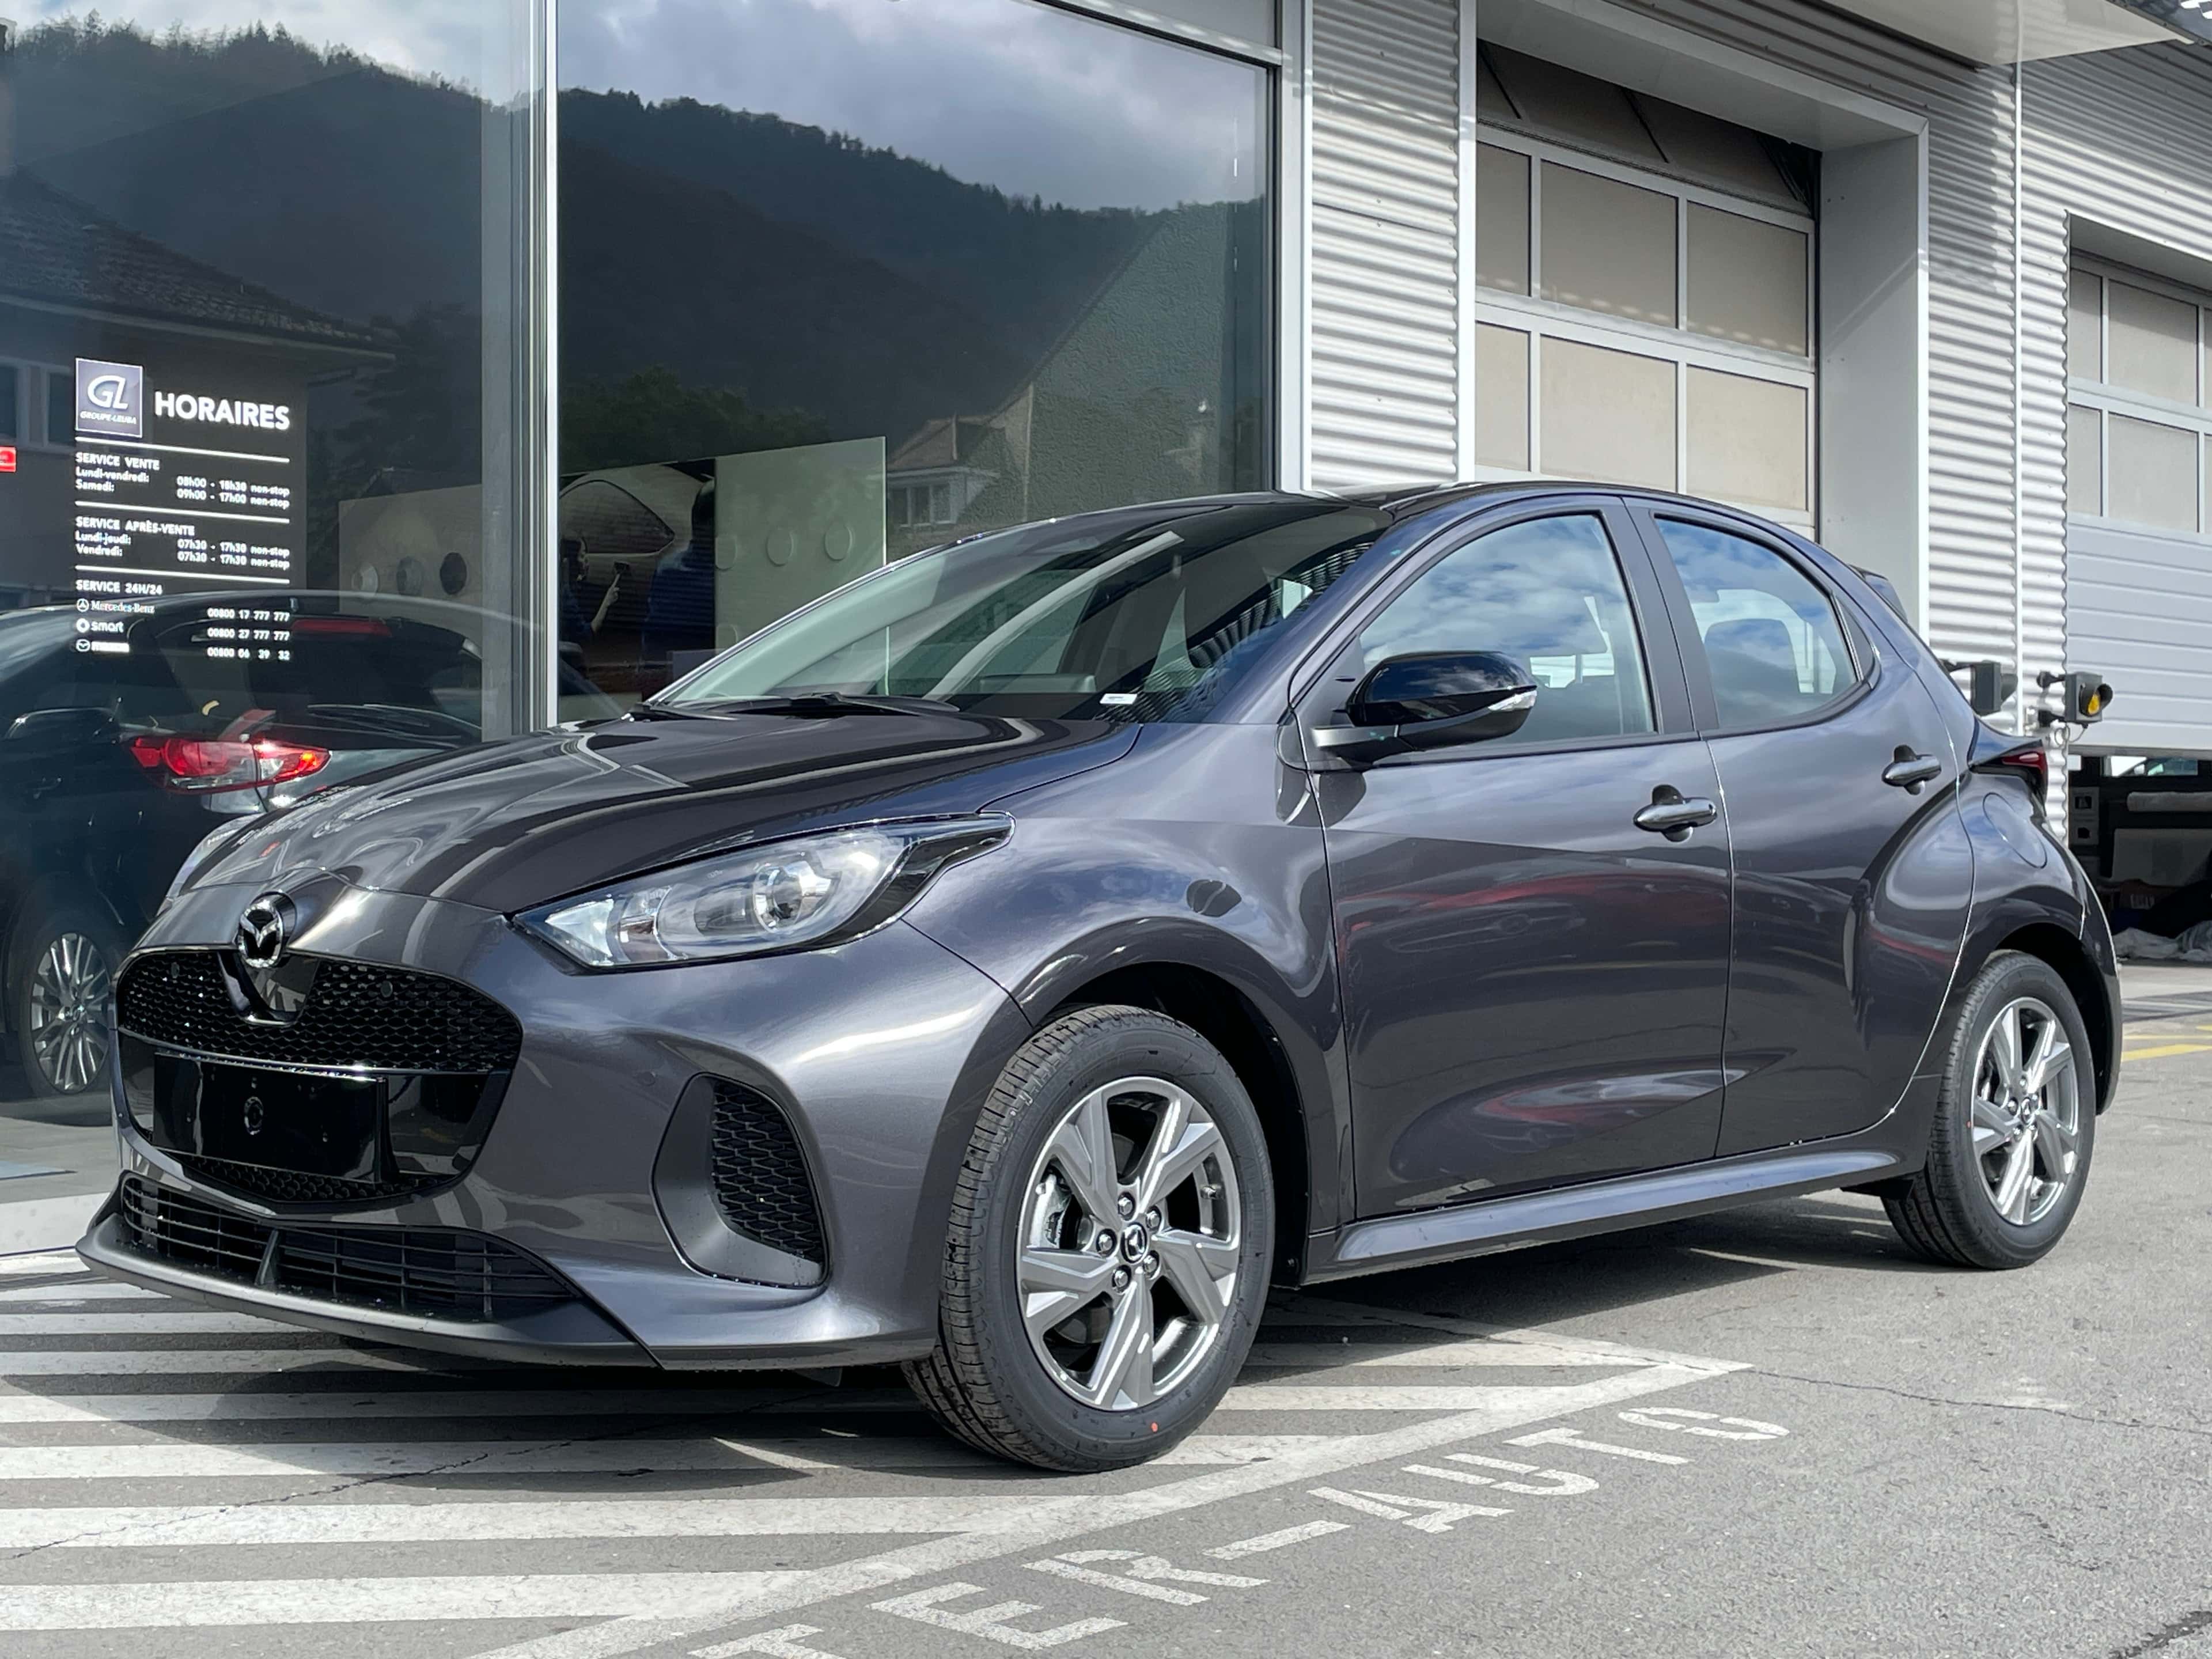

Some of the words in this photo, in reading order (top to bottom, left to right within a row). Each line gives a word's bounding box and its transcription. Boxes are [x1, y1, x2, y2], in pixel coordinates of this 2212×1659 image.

[88, 375, 129, 410] GL
[154, 391, 290, 430] HORAIRES
[75, 452, 120, 467] SERVICE
[125, 457, 160, 471] VENTE
[75, 516, 120, 531] SERVICE
[125, 521, 195, 536] APRÈS-VENTE
[75, 579, 120, 593] SERVICE
[91, 601, 155, 615] Mercedes-Benz
[253, 611, 270, 621] 777
[274, 612, 290, 622] 777
[91, 622, 124, 633] smart
[253, 631, 270, 641] 777
[274, 632, 290, 642] 777
